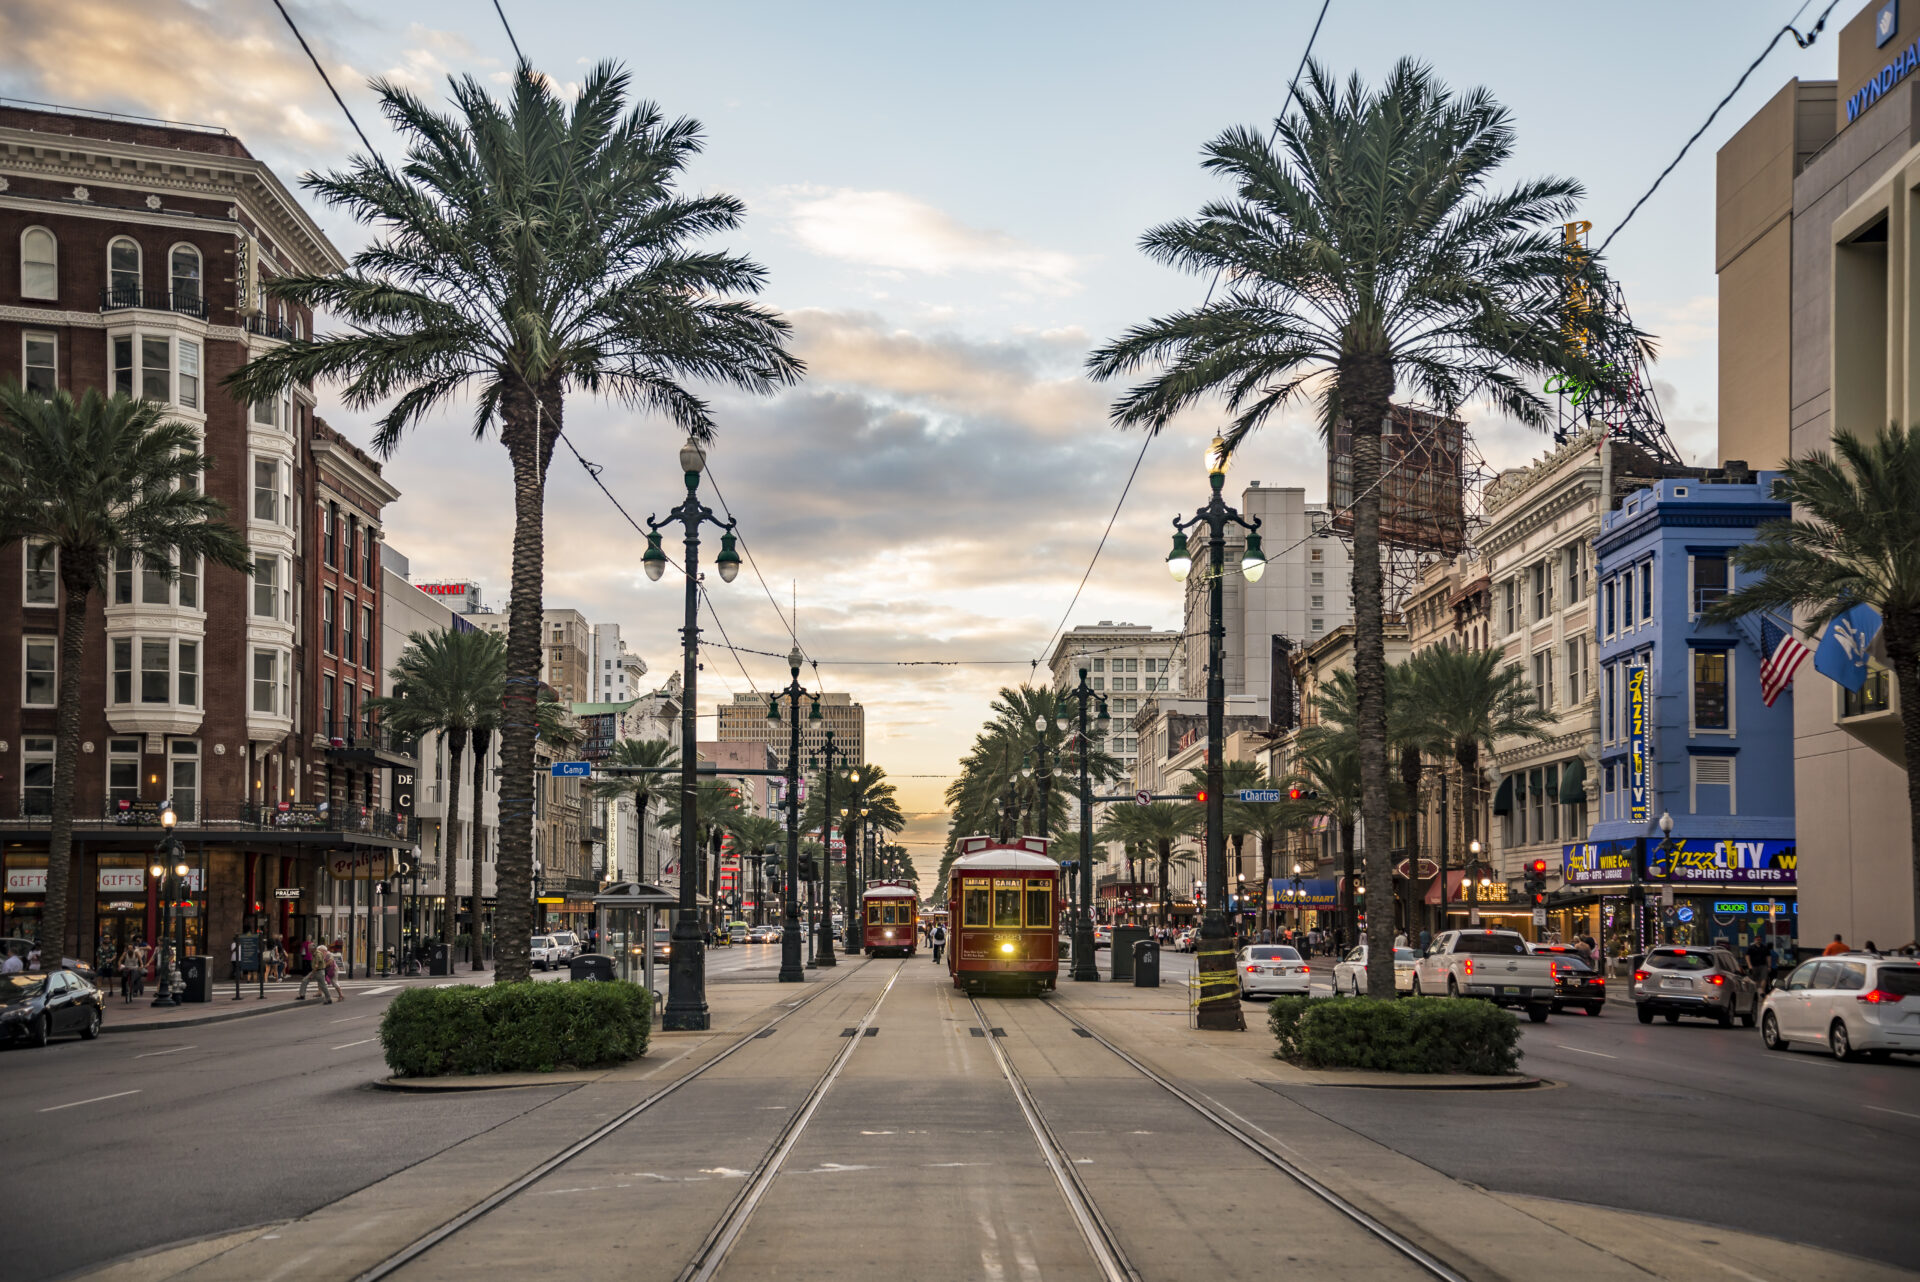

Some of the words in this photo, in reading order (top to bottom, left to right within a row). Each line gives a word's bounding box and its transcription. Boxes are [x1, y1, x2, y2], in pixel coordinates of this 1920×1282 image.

[1846, 37, 1920, 122] WYNDHA
[238, 241, 248, 309] PRALINE
[735, 694, 761, 702] Tulane
[1630, 670, 1645, 735] JAZZ
[563, 764, 584, 775] Camp
[398, 775, 413, 785] DE
[1245, 790, 1279, 801] Chartres
[1600, 855, 1618, 869] WINE
[1686, 869, 1734, 879] SPIRITS
[1747, 870, 1781, 880] GIFTS
[102, 875, 142, 886] GIFTS
